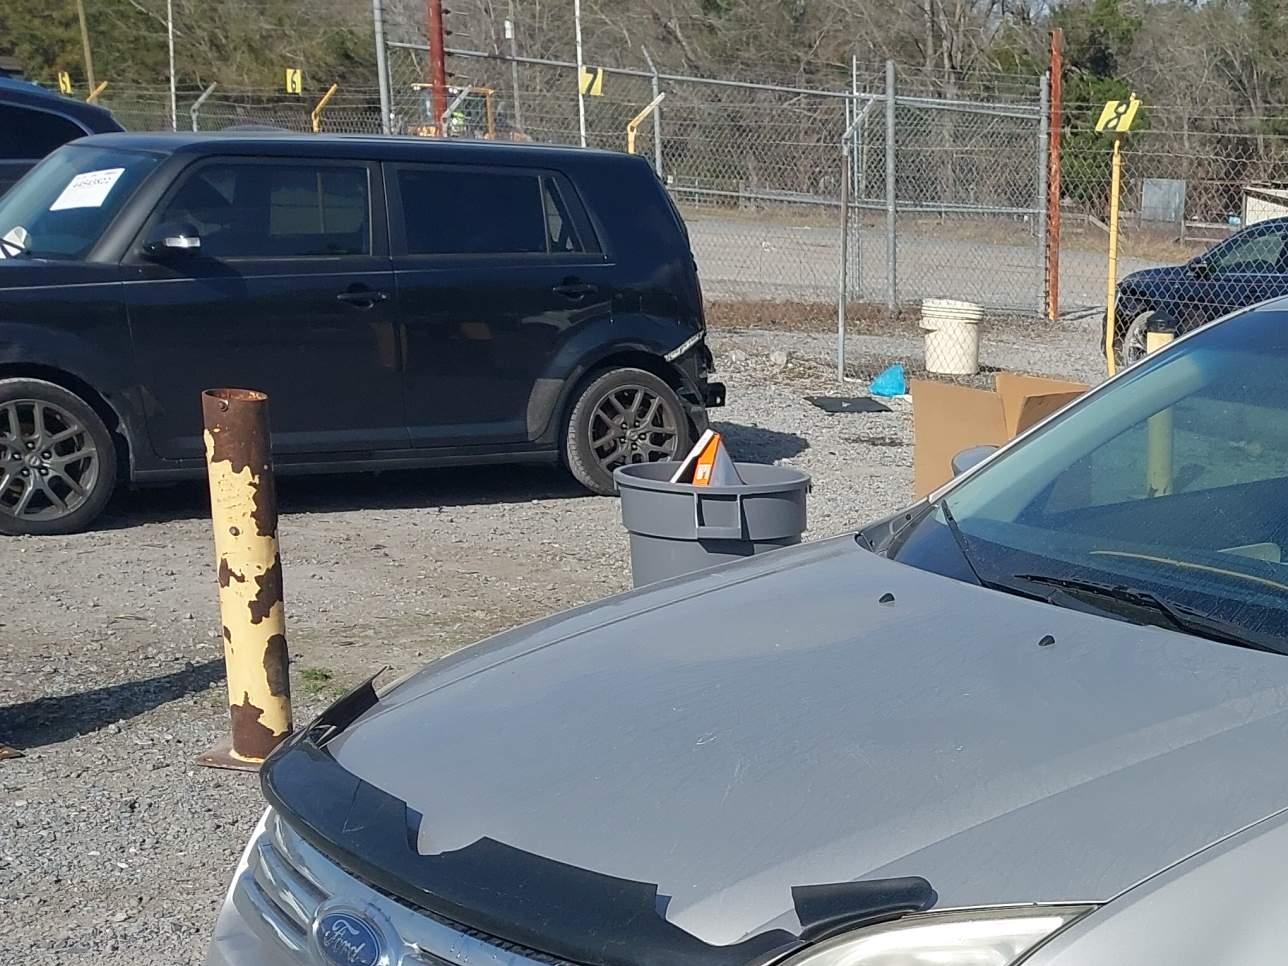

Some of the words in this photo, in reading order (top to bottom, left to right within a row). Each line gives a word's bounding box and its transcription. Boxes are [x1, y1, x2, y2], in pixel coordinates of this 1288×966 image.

[585, 66, 599, 95] 7
[1102, 100, 1130, 131] 8
[324, 919, 367, 963] Ford
